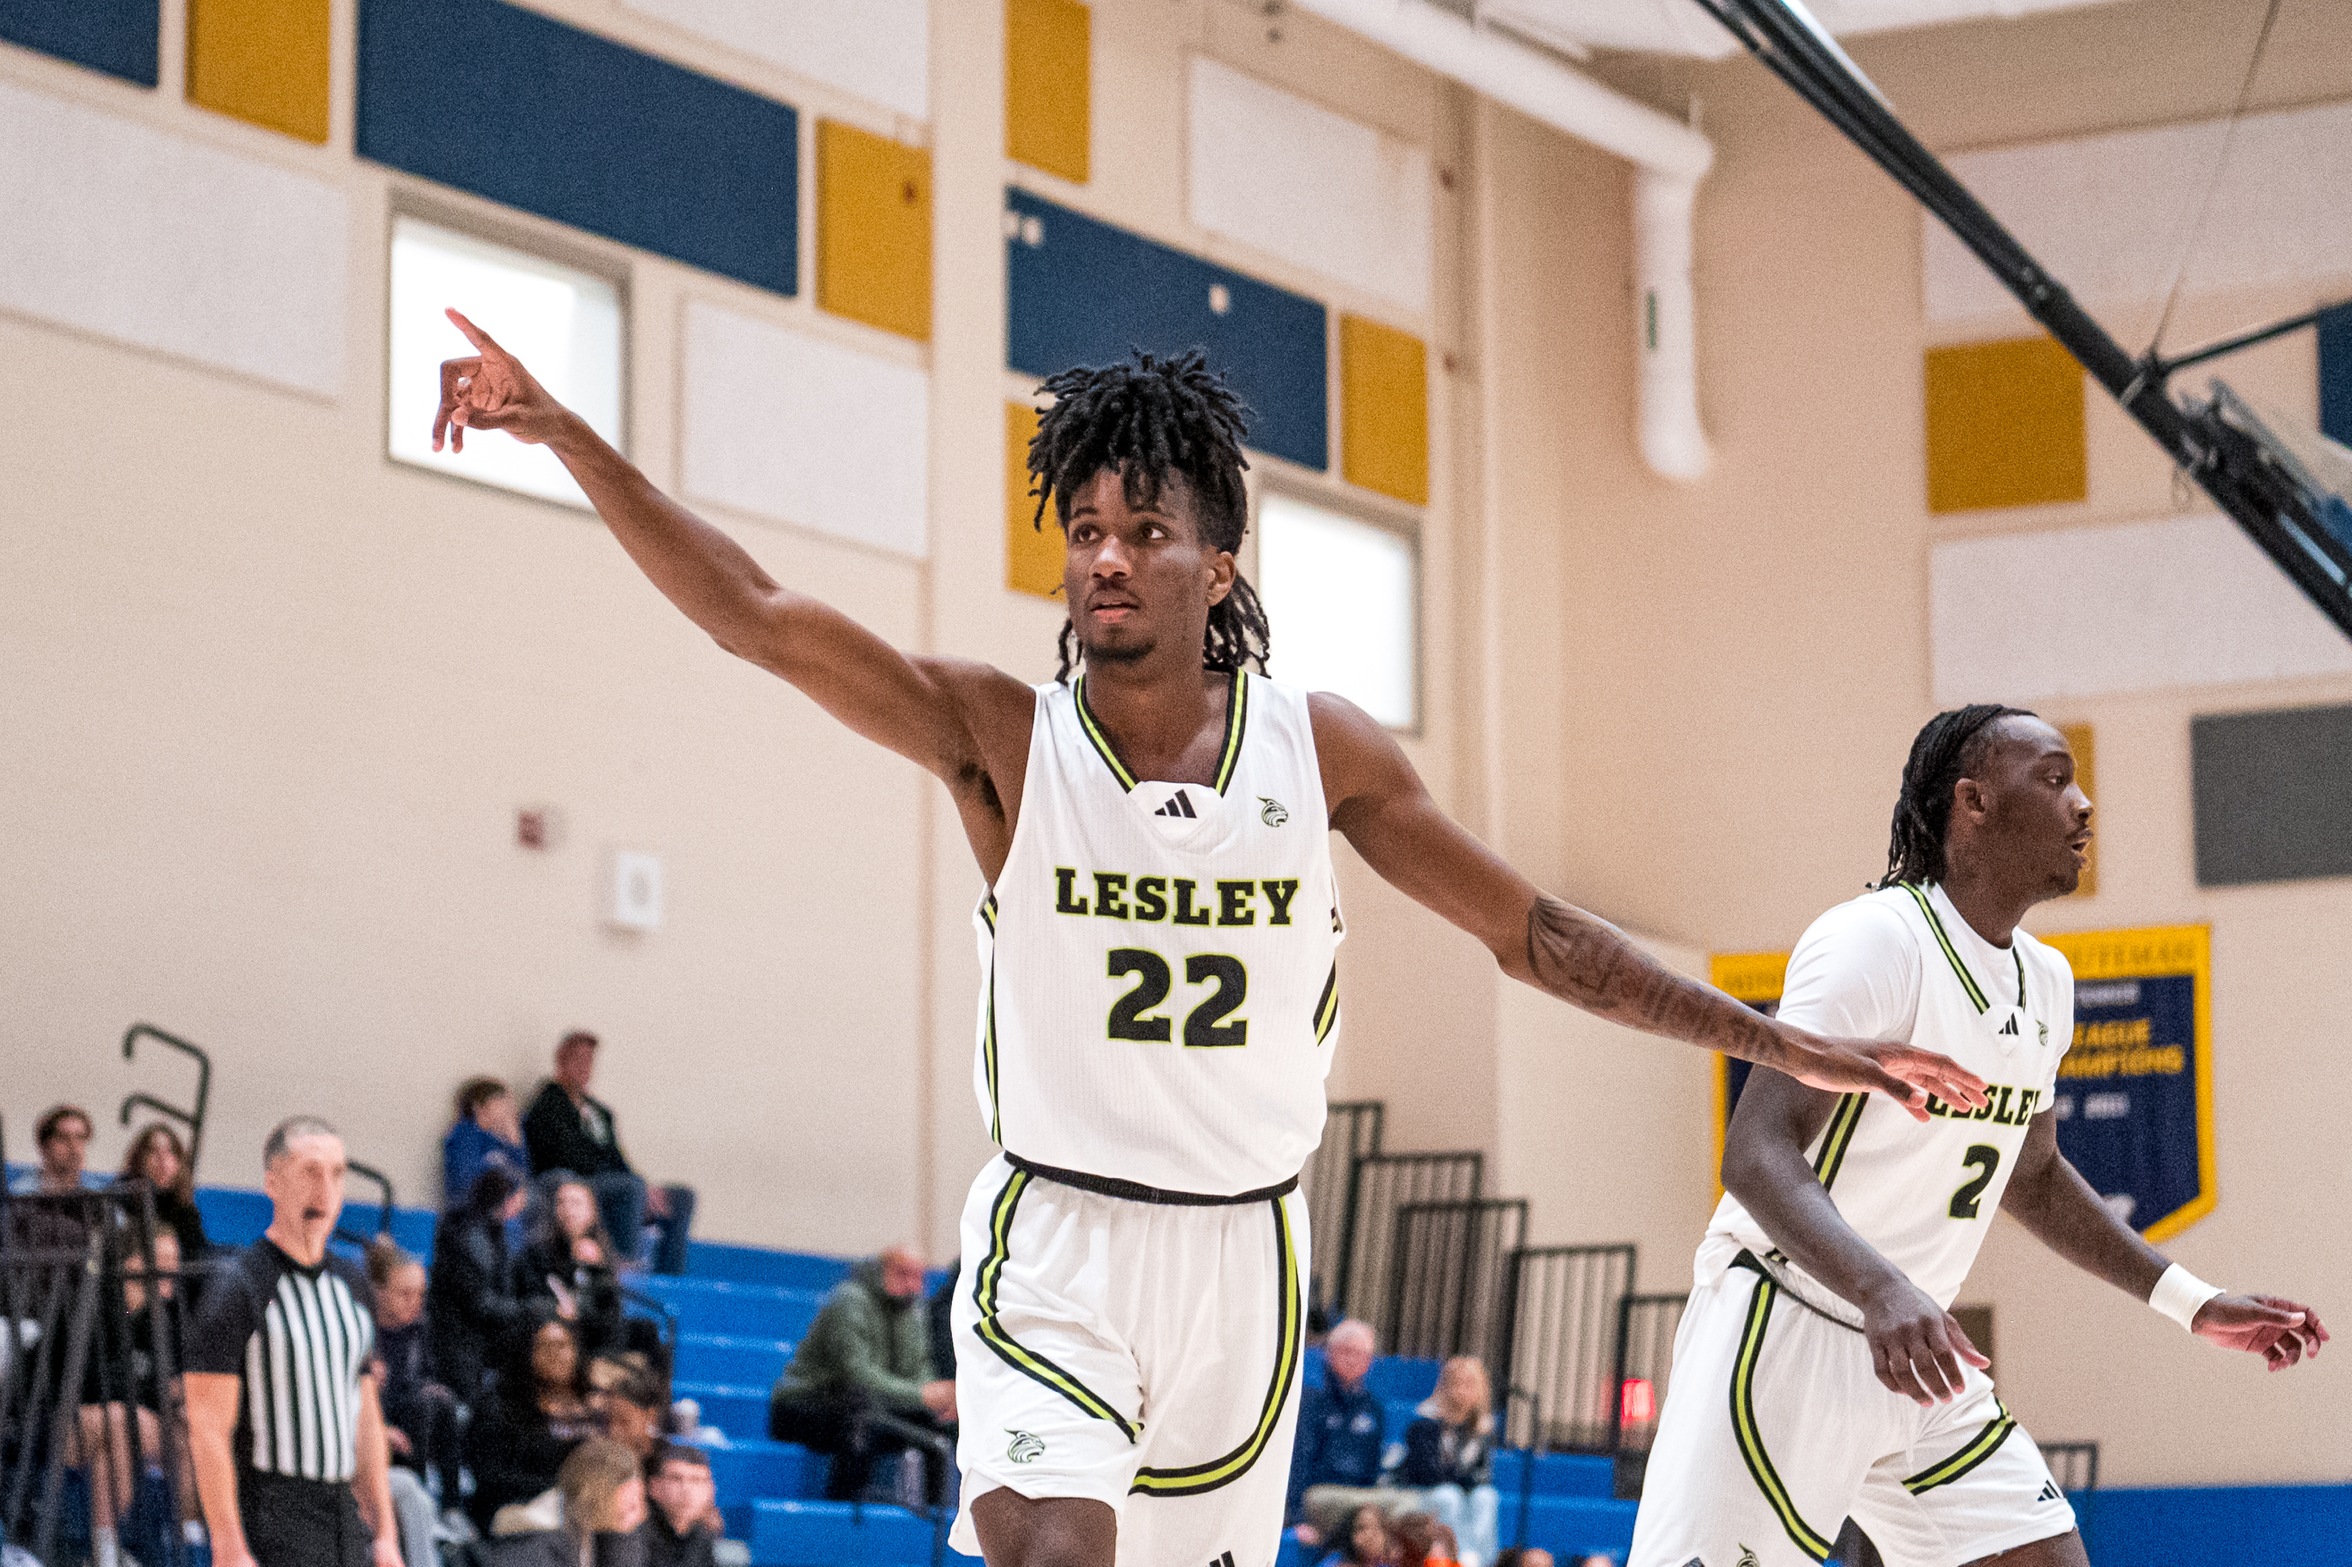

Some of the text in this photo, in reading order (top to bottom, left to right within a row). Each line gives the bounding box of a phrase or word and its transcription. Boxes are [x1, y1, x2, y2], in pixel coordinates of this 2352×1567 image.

[1054, 865, 1300, 928] LESLEY
[1107, 946, 1249, 1049] 22
[1948, 1142, 2000, 1220] 2
